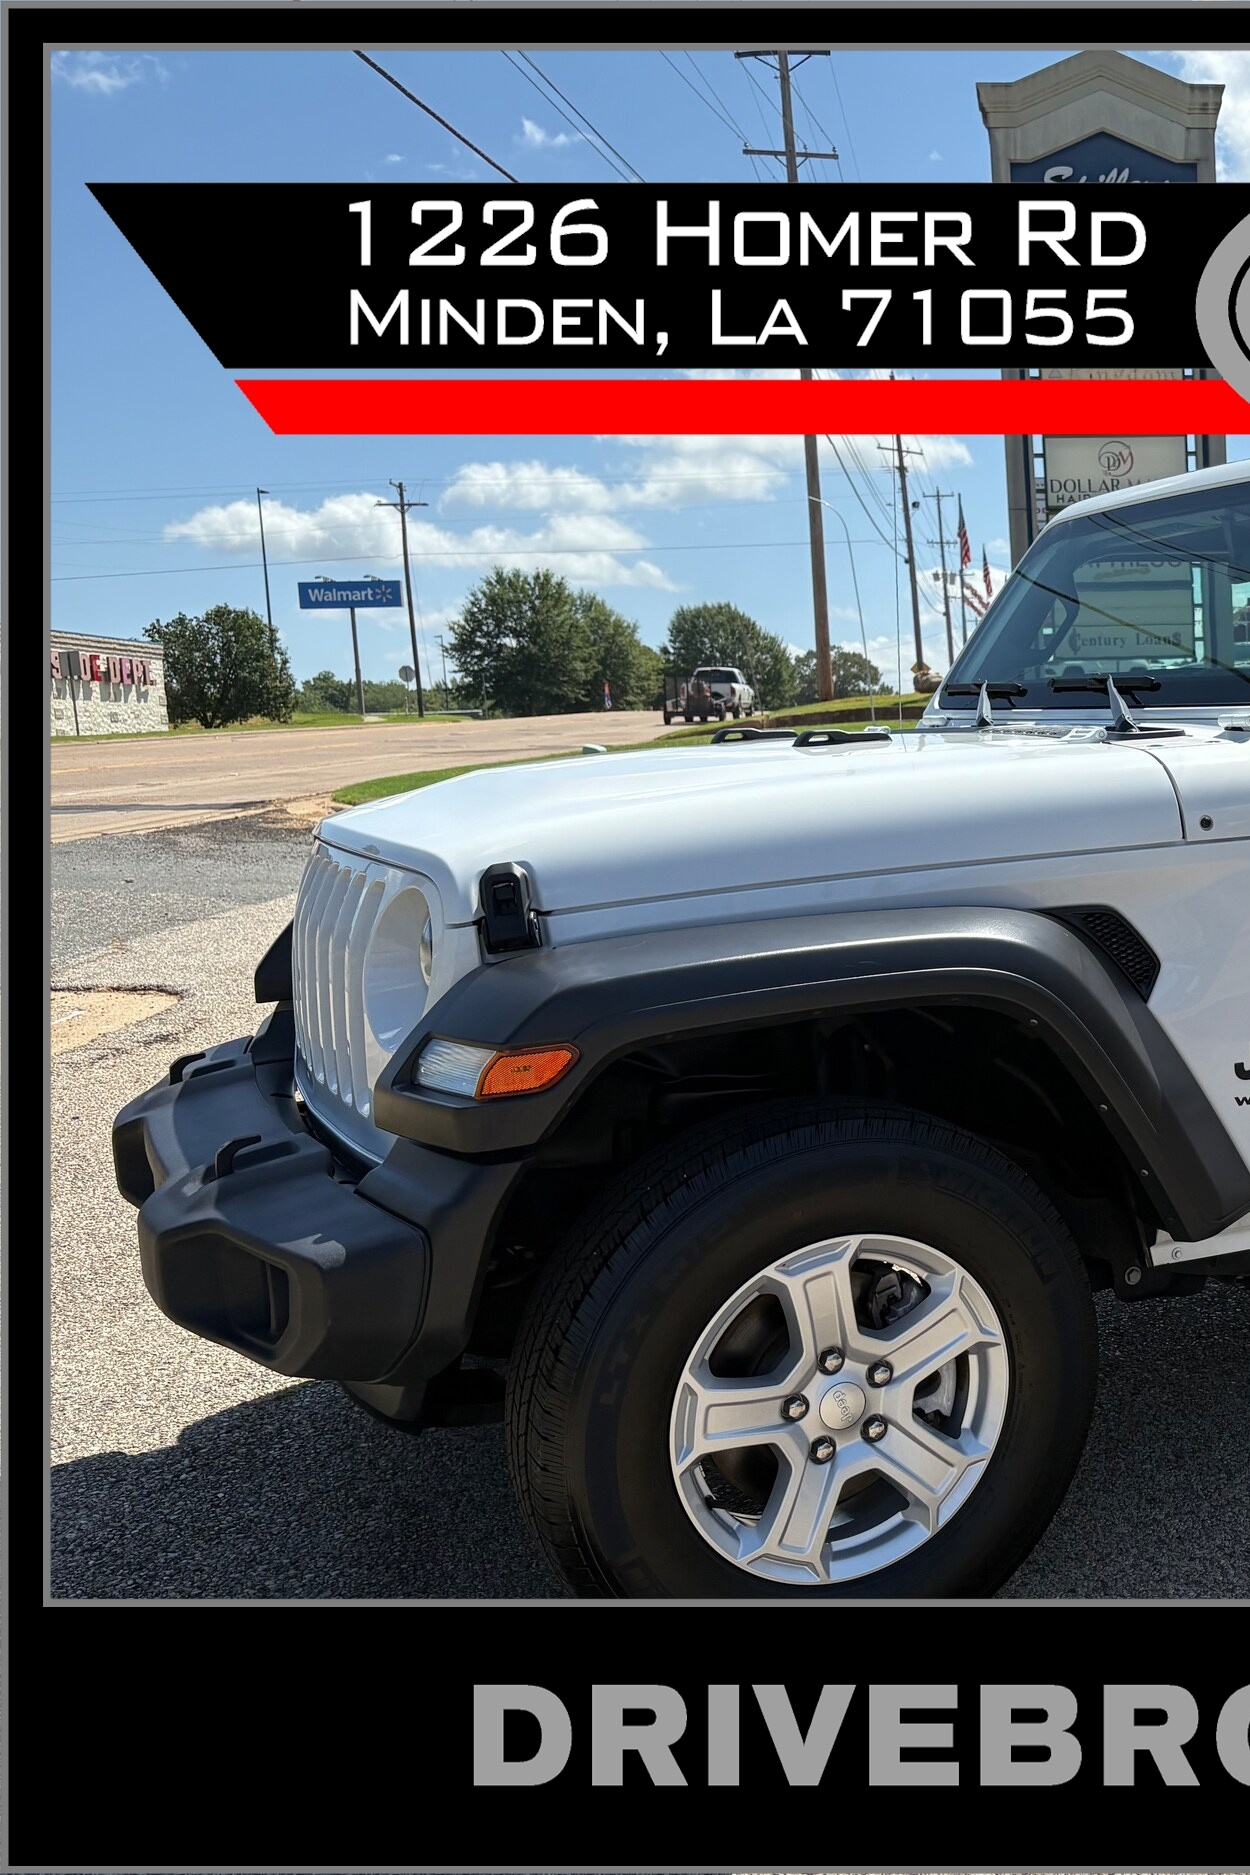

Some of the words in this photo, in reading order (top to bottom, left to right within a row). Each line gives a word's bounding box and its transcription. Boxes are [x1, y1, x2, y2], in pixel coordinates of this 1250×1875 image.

[1050, 478, 1120, 493] DOLLAR
[308, 587, 374, 602] Walmart
[51, 651, 102, 682] SOE
[832, 1390, 854, 1423] Jeep
